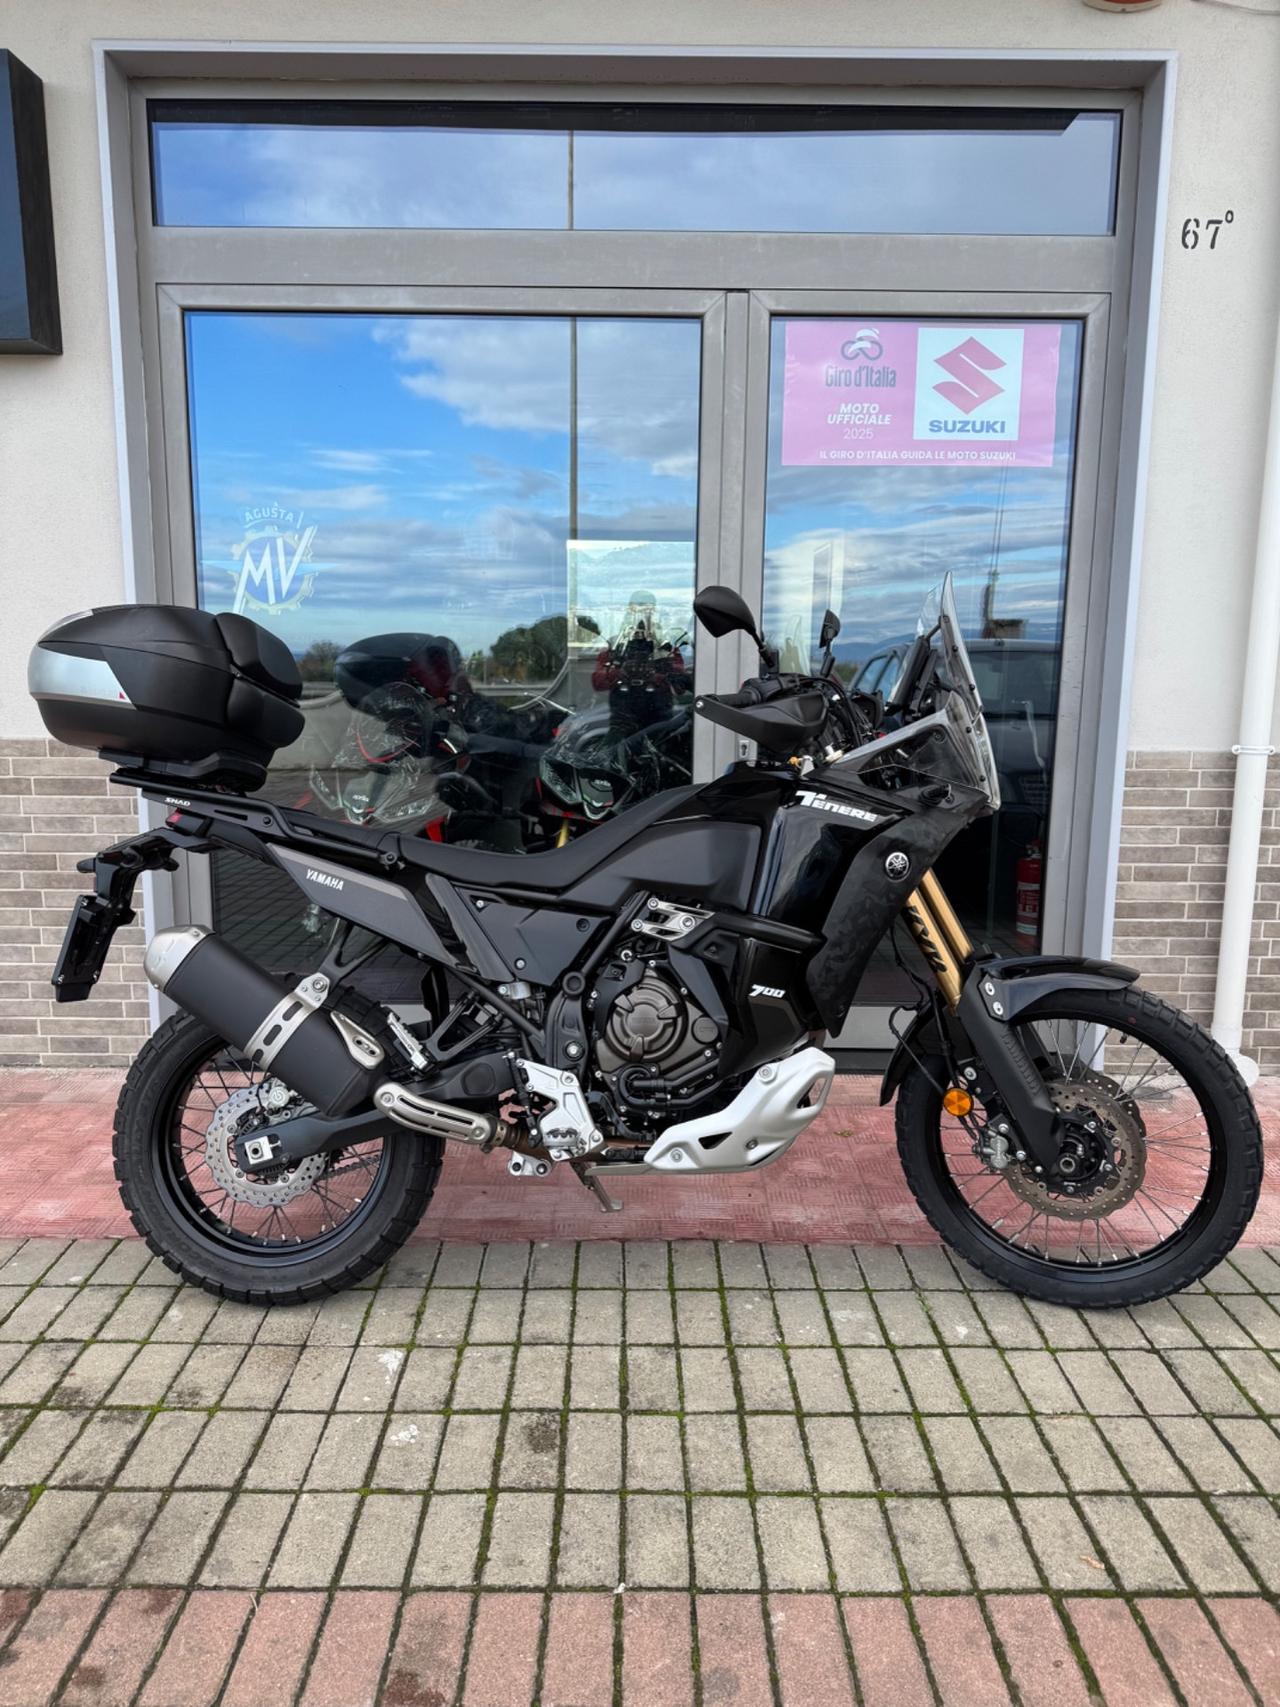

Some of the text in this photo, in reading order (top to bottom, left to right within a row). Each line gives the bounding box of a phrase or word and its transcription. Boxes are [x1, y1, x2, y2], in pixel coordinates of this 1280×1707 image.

[825, 364, 897, 389] Giro d'Italia
[839, 402, 880, 414] MOTO
[827, 413, 892, 425] UFFICIALE
[842, 427, 874, 440] 2025
[928, 419, 1006, 434] SUZUKI
[819, 450, 1016, 461] IL GIRO D'ITALIA GUIDA LE MOTO SUZUKI
[244, 507, 294, 523] AGUSTA
[164, 797, 191, 807] SHAD
[306, 868, 345, 891] YAMAHA
[748, 983, 787, 999] 700
